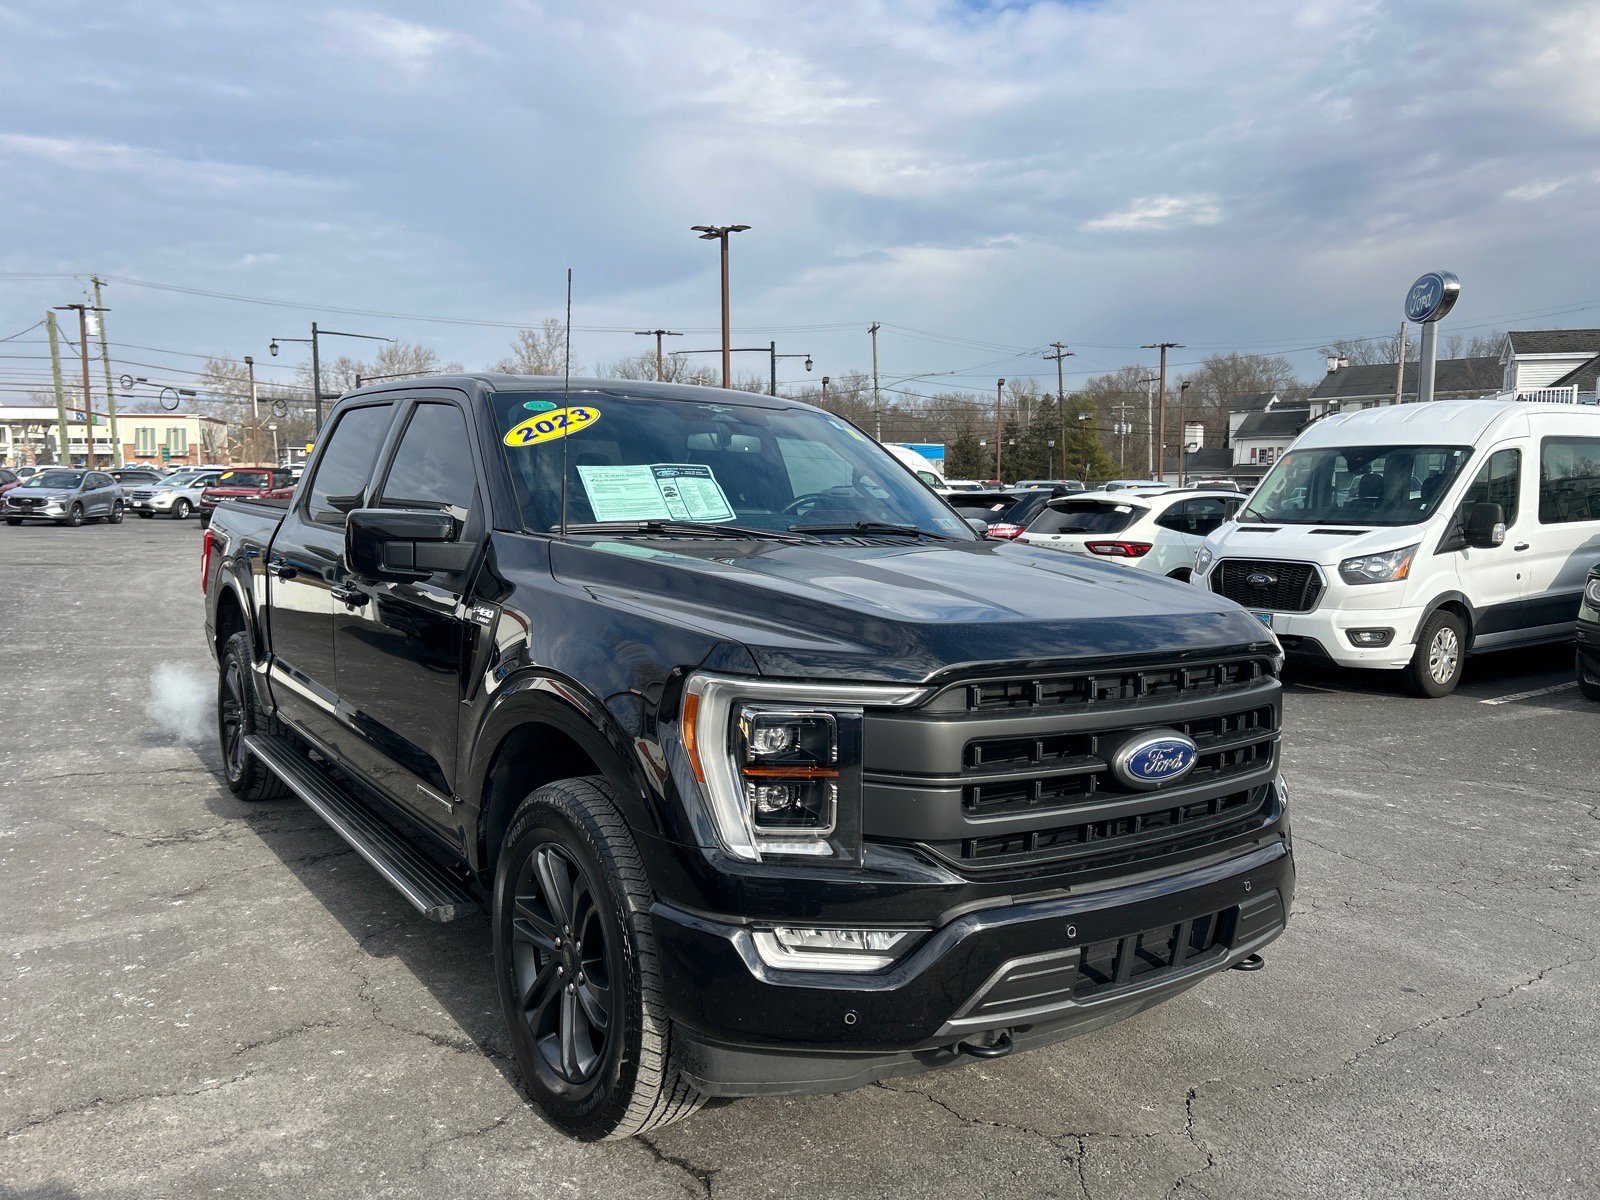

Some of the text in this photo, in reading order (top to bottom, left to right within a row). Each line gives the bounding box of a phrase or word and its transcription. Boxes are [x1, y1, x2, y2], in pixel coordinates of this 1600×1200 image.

[1410, 282, 1434, 314] Ford
[516, 408, 590, 443] 2023
[1143, 747, 1183, 774] Ford
